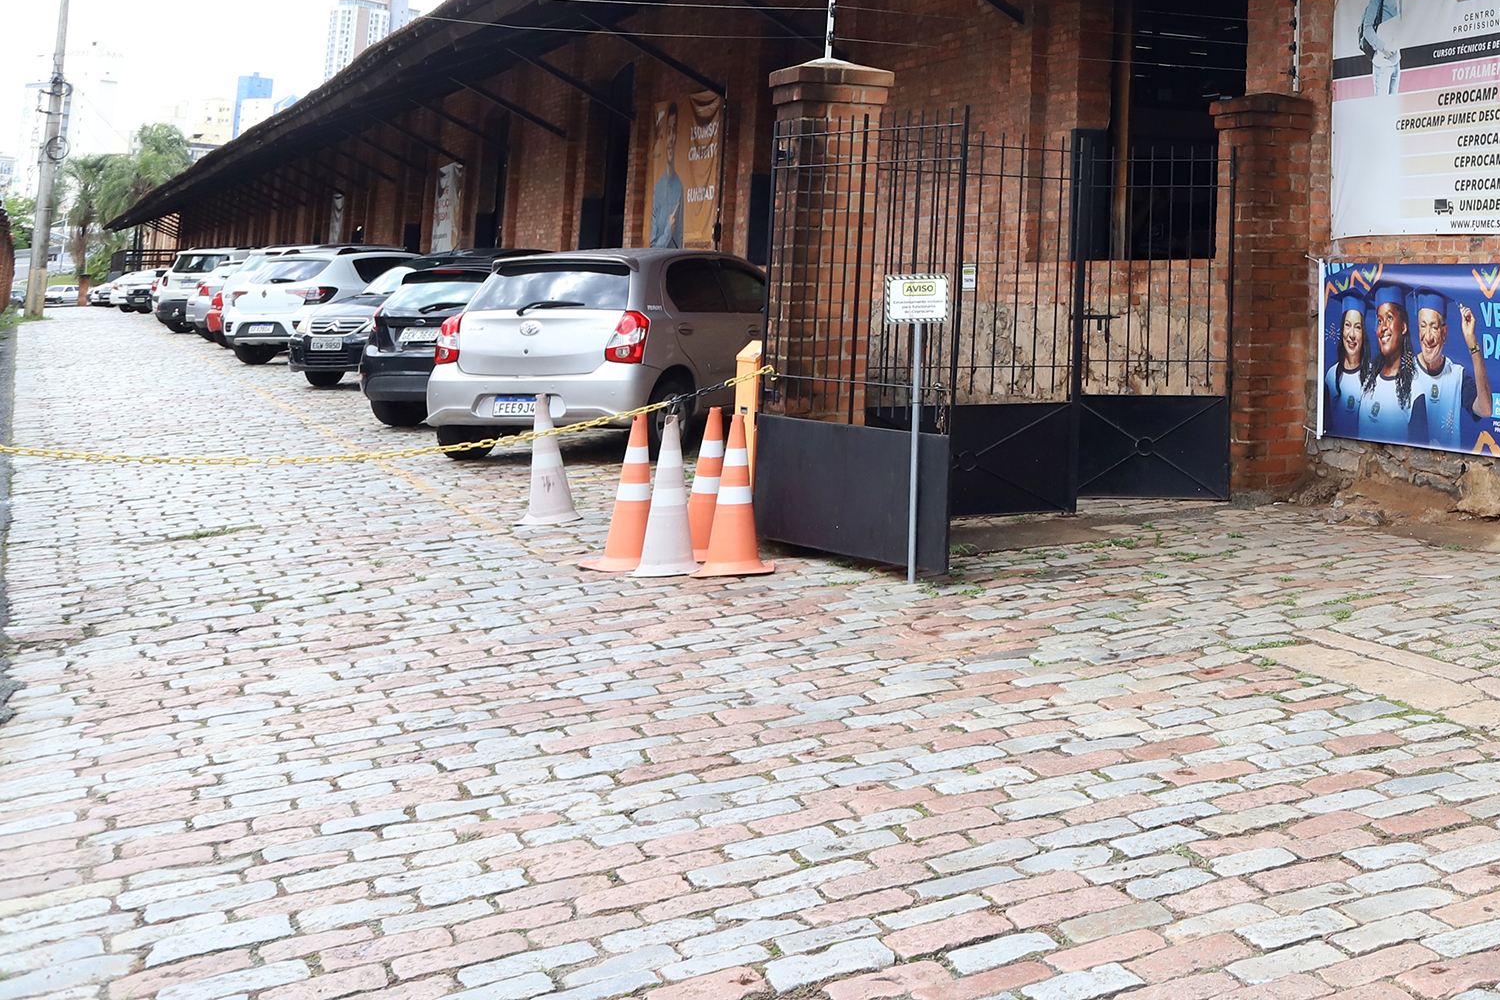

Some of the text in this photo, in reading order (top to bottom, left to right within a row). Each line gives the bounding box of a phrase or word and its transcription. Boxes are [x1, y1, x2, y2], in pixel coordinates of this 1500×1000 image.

[1464, 9, 1494, 22] CENTRO
[1433, 46, 1456, 59] CURSOS
[1457, 40, 1486, 55] TÉCNICOS
[1487, 41, 1492, 50] E
[1492, 40, 1500, 49] DE
[1438, 86, 1498, 106] CEPROCAMP
[1396, 113, 1446, 131] CEPROCAMP
[1447, 109, 1477, 126] FUMEC
[1459, 199, 1500, 212] UNIDADE
[498, 402, 535, 413] FEE9J4
